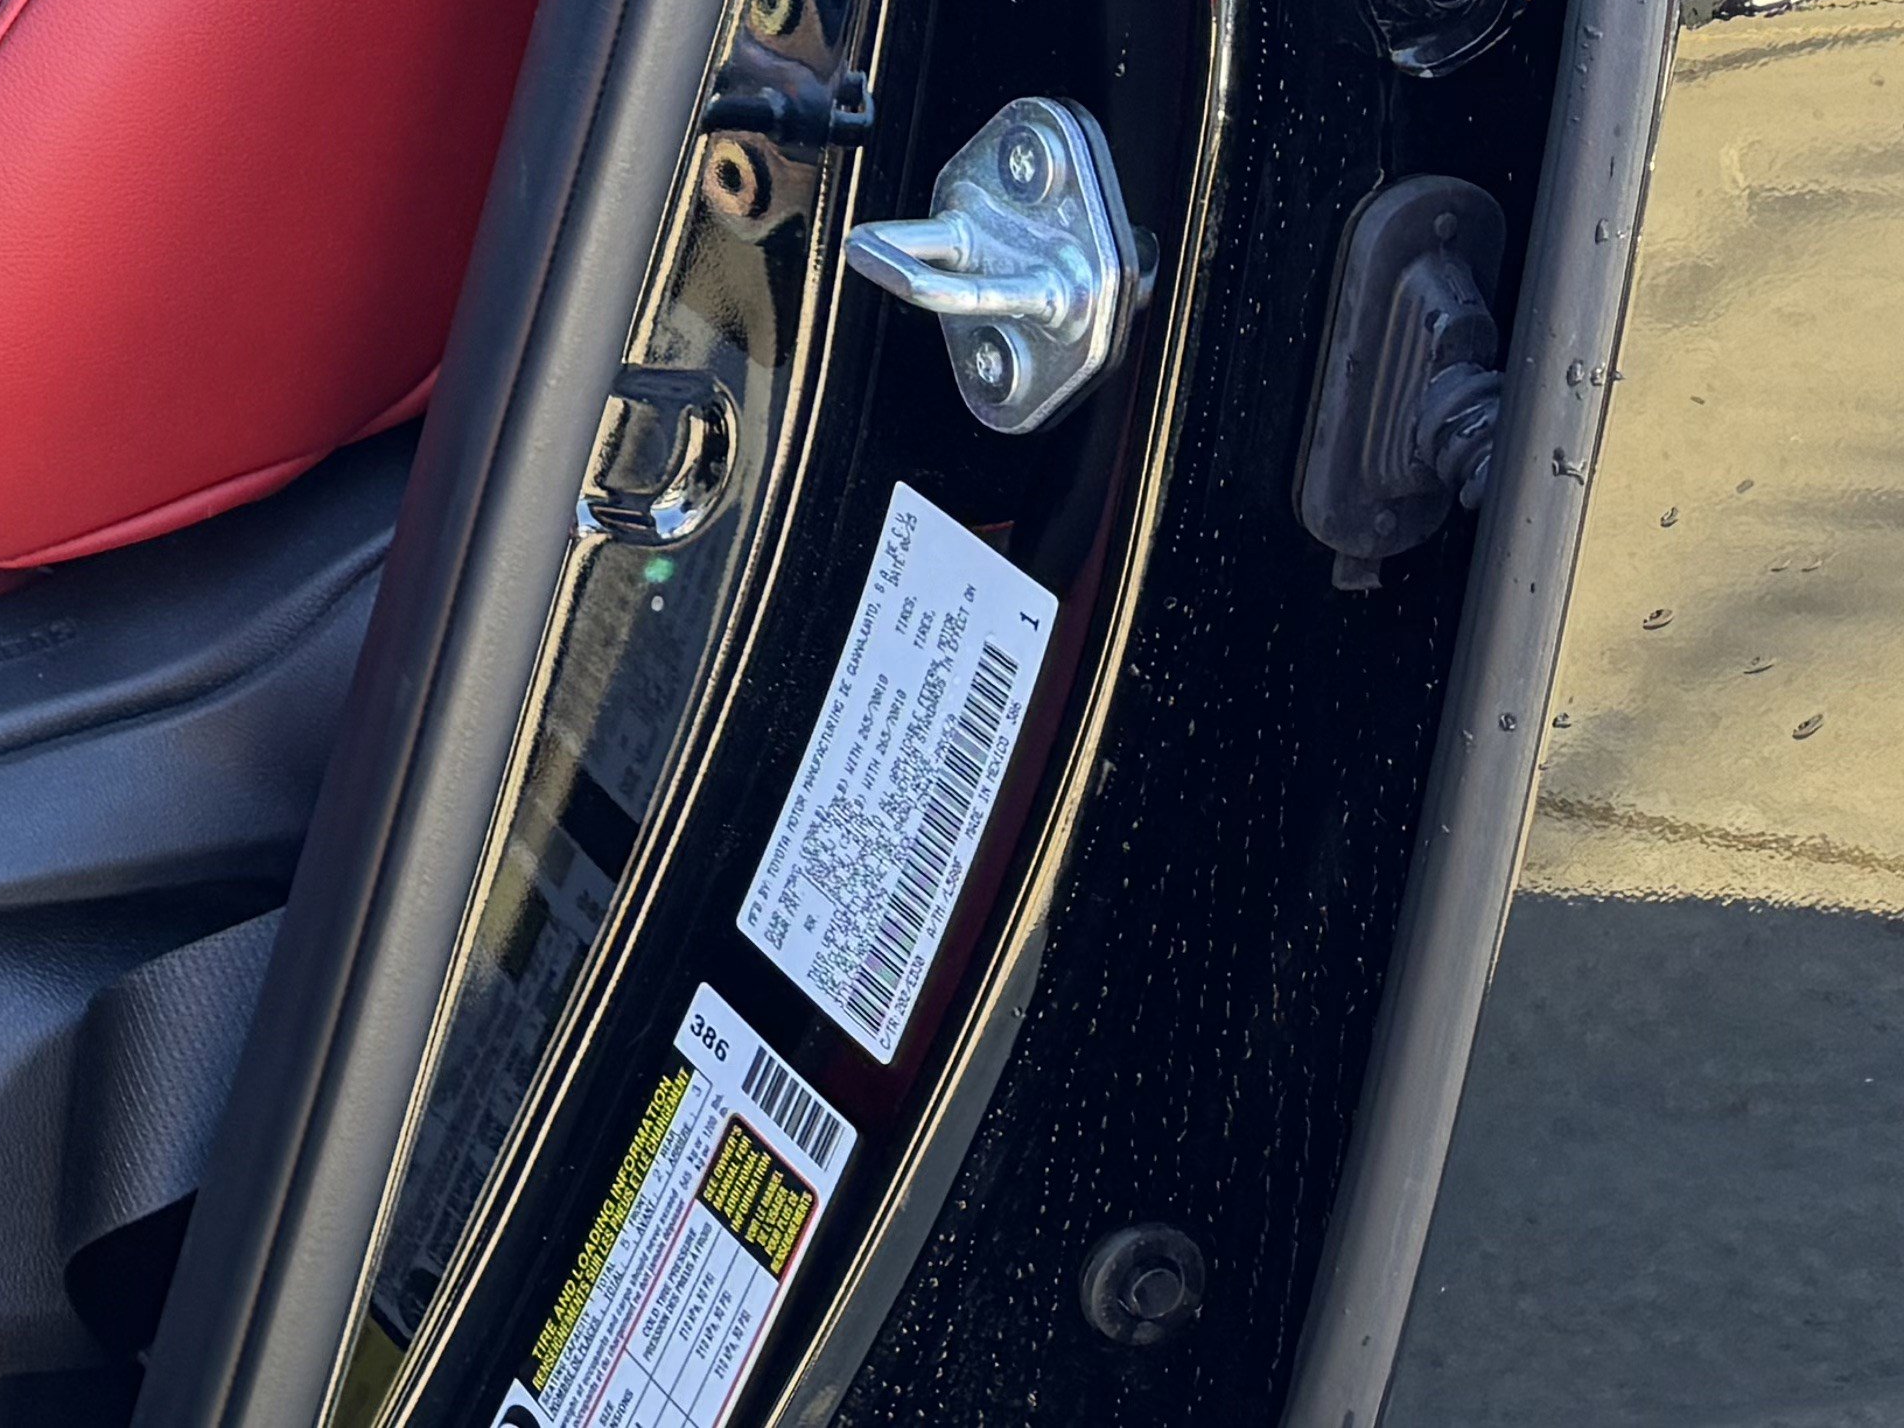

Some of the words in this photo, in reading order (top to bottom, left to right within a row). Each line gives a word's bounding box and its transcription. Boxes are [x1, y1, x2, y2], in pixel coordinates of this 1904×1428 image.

[1019, 611, 1039, 631] 1
[844, 741, 862, 774] WITH
[861, 757, 880, 790] WITH
[985, 735, 1008, 782] MEXICO
[766, 835, 790, 877] TOYOTA
[786, 794, 806, 832] MOTOR
[802, 699, 844, 791] MANUFACTURING
[690, 1013, 731, 1062] 386
[642, 1068, 688, 1153] CHARGEMENT
[629, 1168, 642, 1189] ET
[637, 1150, 651, 1172] LE
[703, 1178, 717, 1201] SEE
[713, 1125, 741, 1178] OWNER'S
[712, 1162, 739, 1210] MANUAL
[735, 1135, 751, 1160] FOR
[724, 1150, 757, 1217] ADDITIONAL
[608, 1186, 634, 1227] PNEUS
[730, 1152, 770, 1231] INFORMATION
[760, 1170, 783, 1207] MANUEL
[532, 1318, 556, 1358] TIRE
[553, 1279, 575, 1320] AND
[572, 1199, 615, 1279] LOADING
[611, 1076, 674, 1198] INFORMATION
[764, 1228, 781, 1255] POUR
[776, 1204, 792, 1230] PLUS
[770, 1191, 811, 1272] RENSEIGNEMENTS
[598, 1229, 615, 1255] LES
[585, 1254, 603, 1282] SUR
[595, 1262, 615, 1292] TOTAL
[642, 1307, 659, 1337] COLD
[667, 1227, 696, 1283] PRESSURE
[532, 1280, 589, 1389] RENSEIGNEMENTS
[642, 1313, 669, 1361] PRESSION
